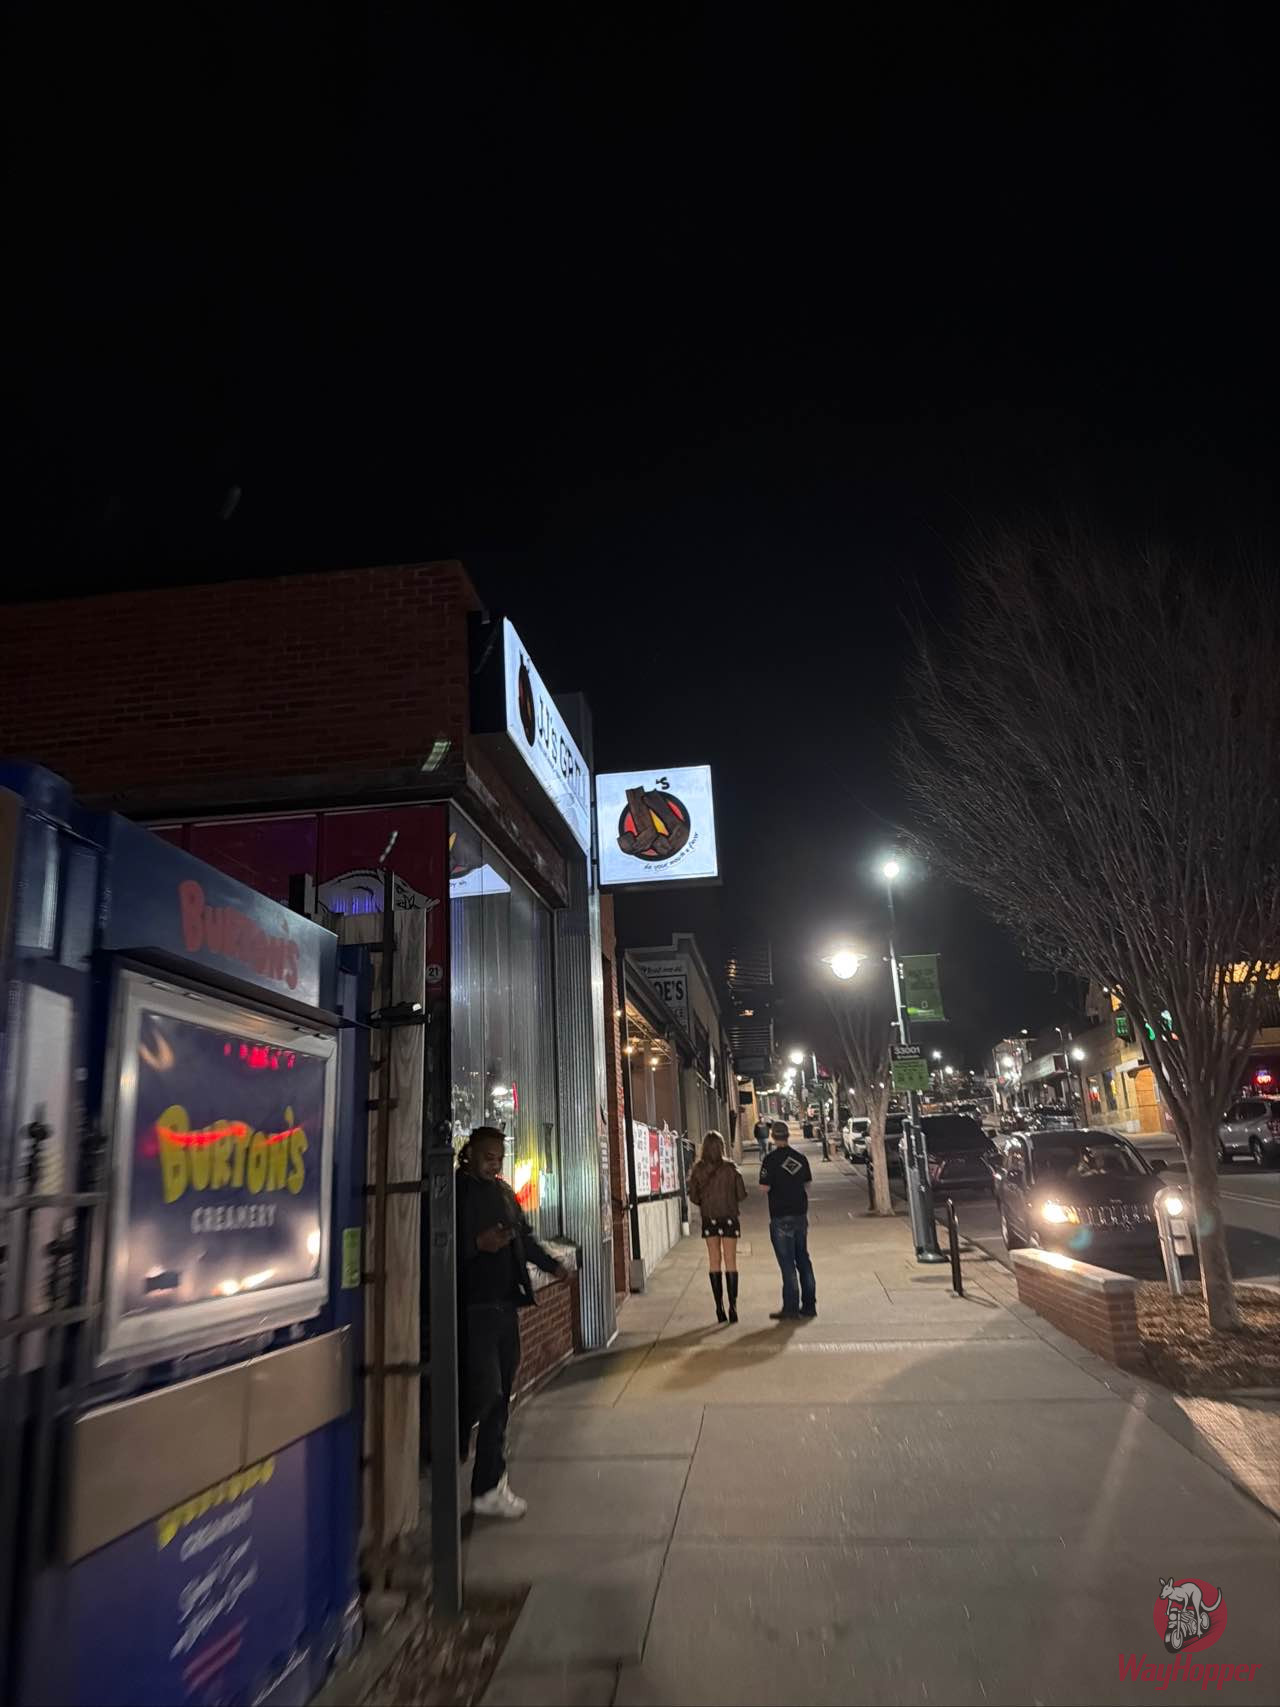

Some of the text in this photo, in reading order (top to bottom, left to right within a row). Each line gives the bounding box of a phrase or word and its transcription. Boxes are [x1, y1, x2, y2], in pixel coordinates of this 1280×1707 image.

[429, 968, 438, 977] 21
[158, 1104, 310, 1204] BURTON'S
[191, 1204, 278, 1235] CREAMERY
